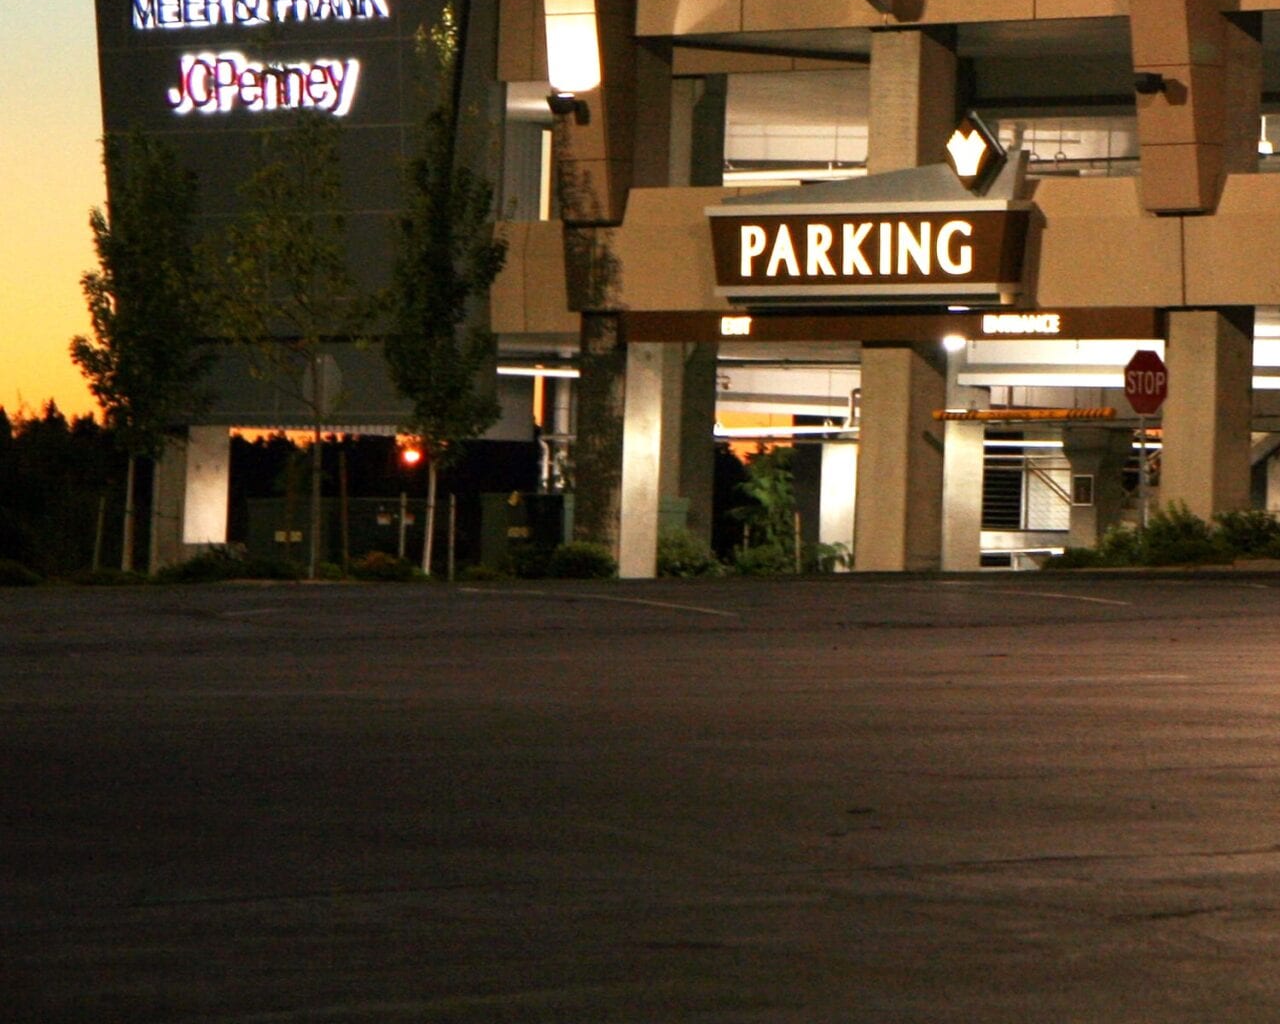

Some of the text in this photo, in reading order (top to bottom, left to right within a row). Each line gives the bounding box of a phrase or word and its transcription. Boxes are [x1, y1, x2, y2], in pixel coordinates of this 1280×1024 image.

[167, 52, 362, 116] JCPenney
[740, 221, 973, 277] PARKING
[1127, 371, 1167, 394] STOP
